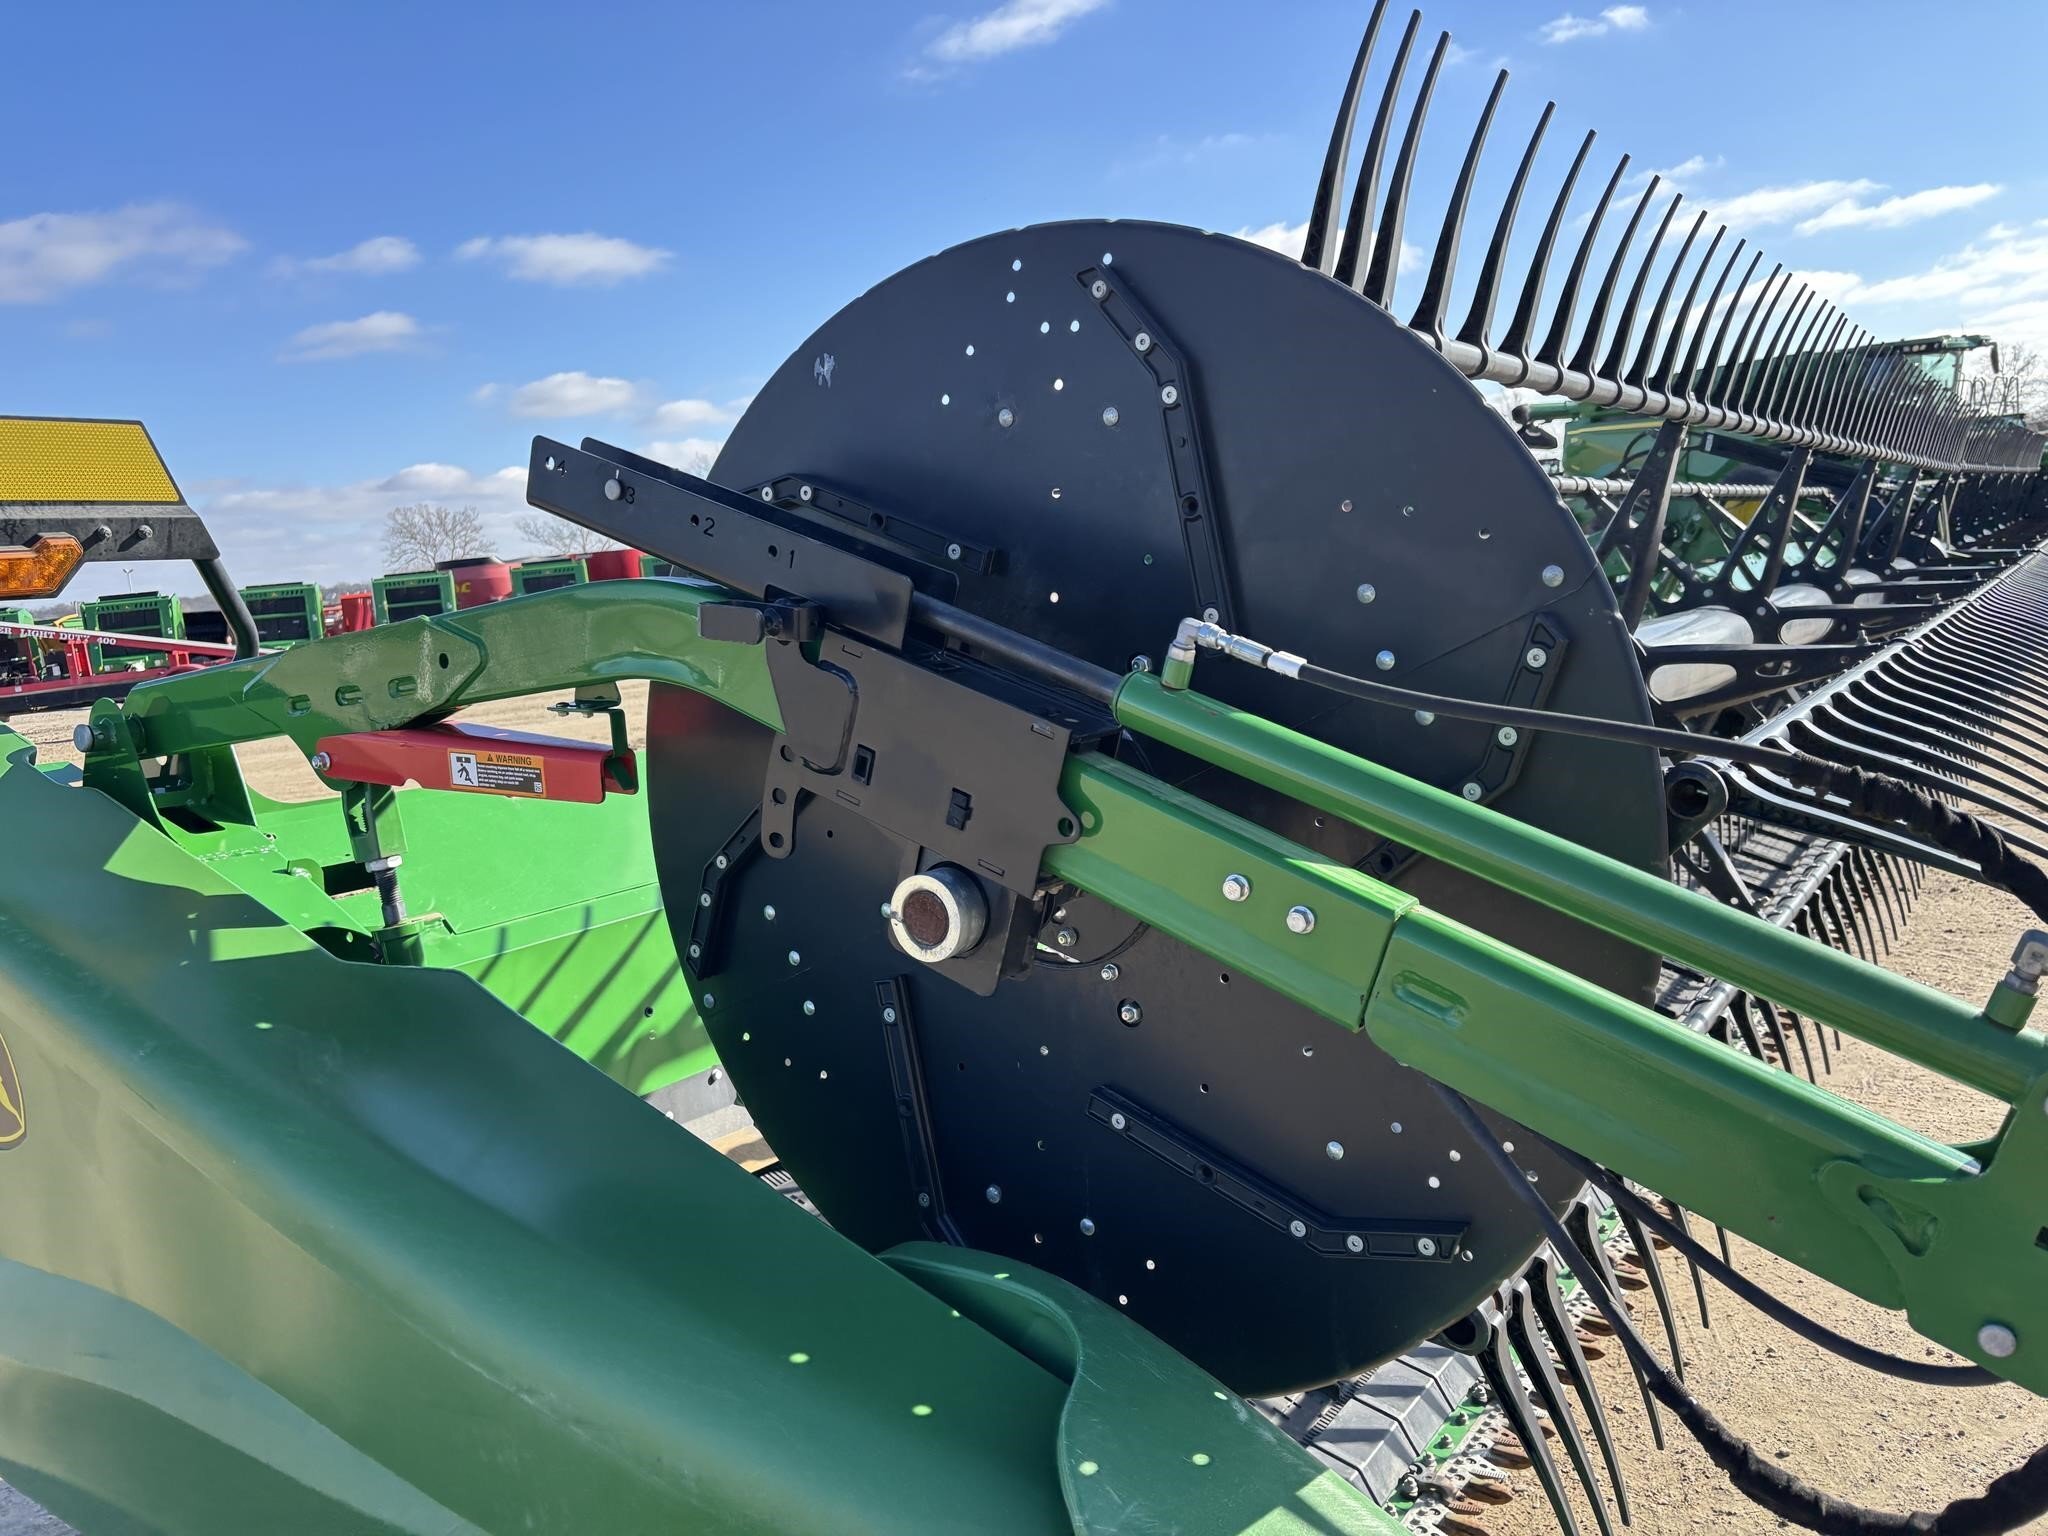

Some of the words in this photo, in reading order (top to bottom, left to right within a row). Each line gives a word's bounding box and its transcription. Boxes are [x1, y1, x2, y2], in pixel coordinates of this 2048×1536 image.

[556, 460, 568, 477] 4
[624, 486, 635, 505] 3
[703, 517, 715, 538] 2
[788, 549, 796, 569] 1
[20, 629, 56, 640] LIGHT
[59, 632, 90, 642] DUTY
[96, 637, 117, 645] 400
[495, 754, 532, 766] WARNING
